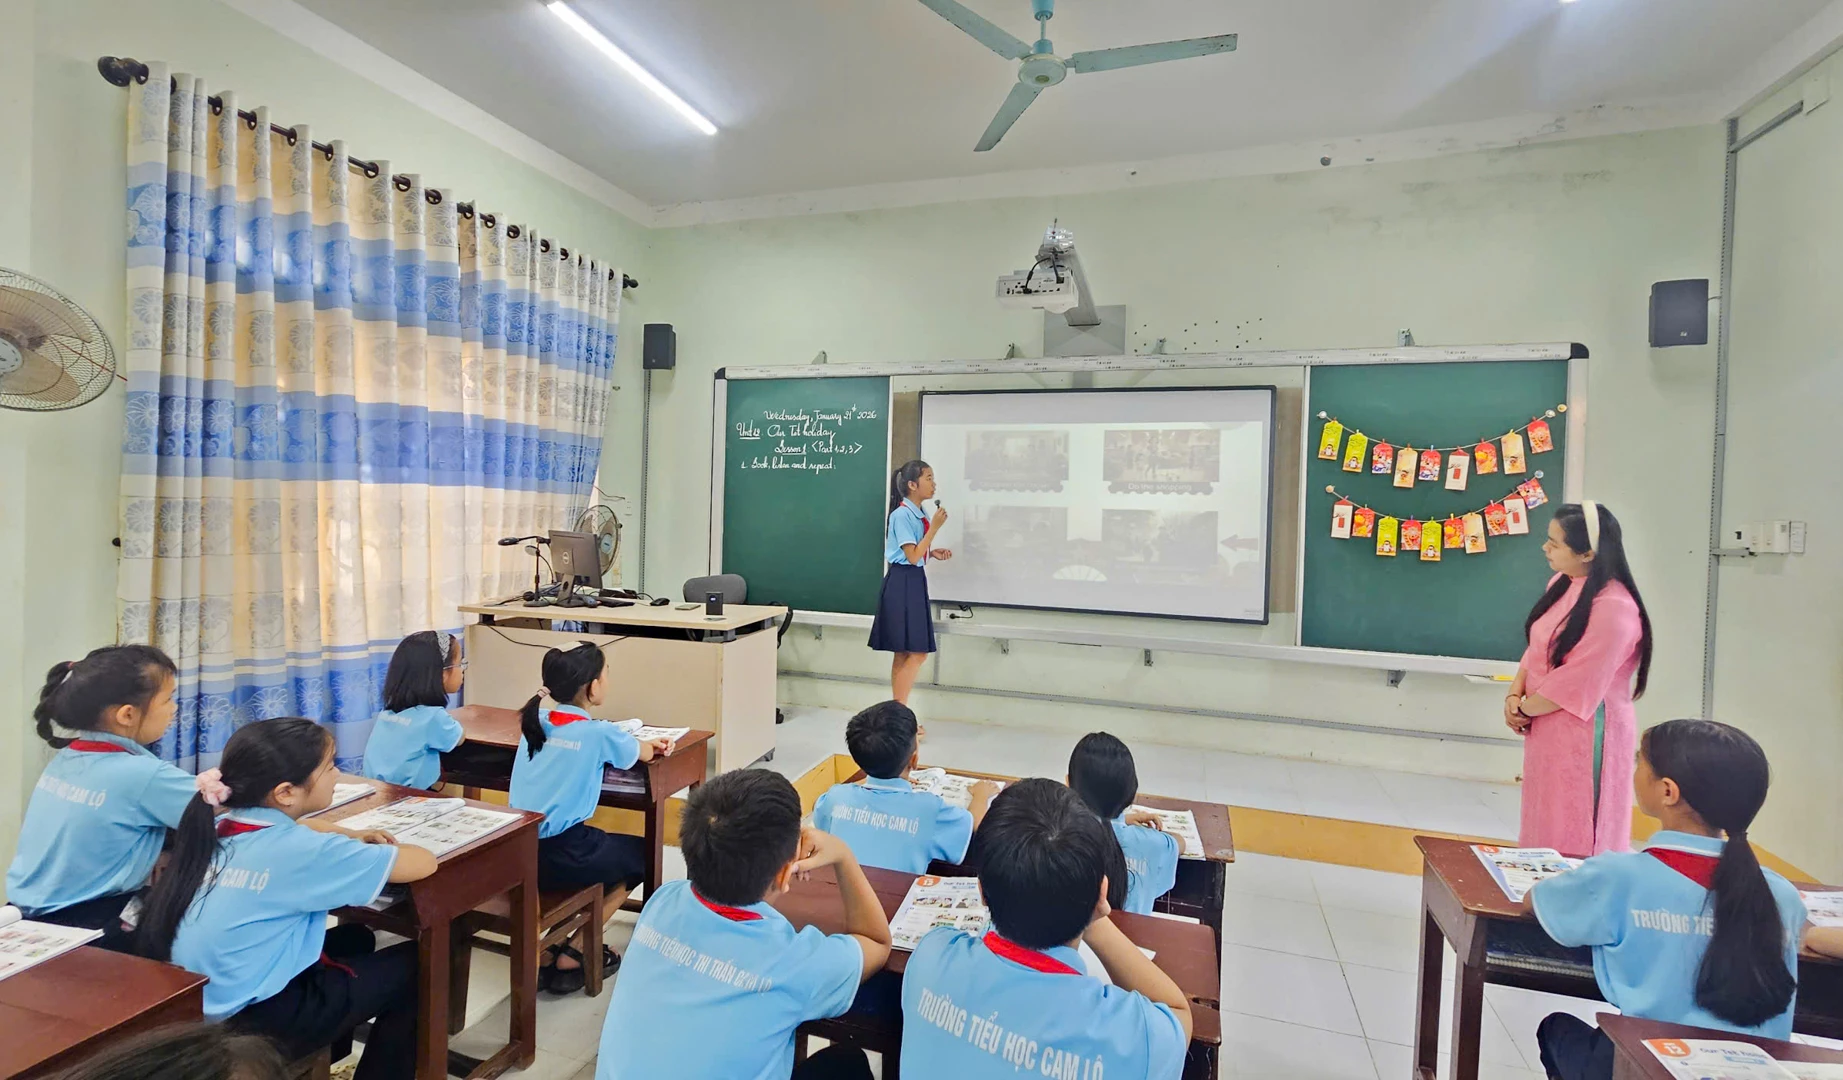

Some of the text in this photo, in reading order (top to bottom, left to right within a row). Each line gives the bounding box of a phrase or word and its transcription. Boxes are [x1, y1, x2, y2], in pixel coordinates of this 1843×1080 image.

[763, 408, 813, 426] Wednesday,
[812, 410, 842, 427] January
[857, 410, 877, 420] 2026
[767, 424, 786, 437] Our
[791, 456, 807, 470] and
[87, 788, 107, 811] LỘ
[870, 811, 888, 831] HỌC
[888, 815, 908, 833] CAM
[907, 816, 919, 838] LỘ
[220, 867, 250, 889] CAM
[248, 867, 270, 895] LỘ
[1631, 907, 1690, 934] TRƯỜNG
[917, 987, 968, 1038] TRƯỜNG
[968, 1011, 1004, 1055] TIỂU
[1002, 1031, 1038, 1073] HỌC
[1040, 1046, 1080, 1080] CAM
